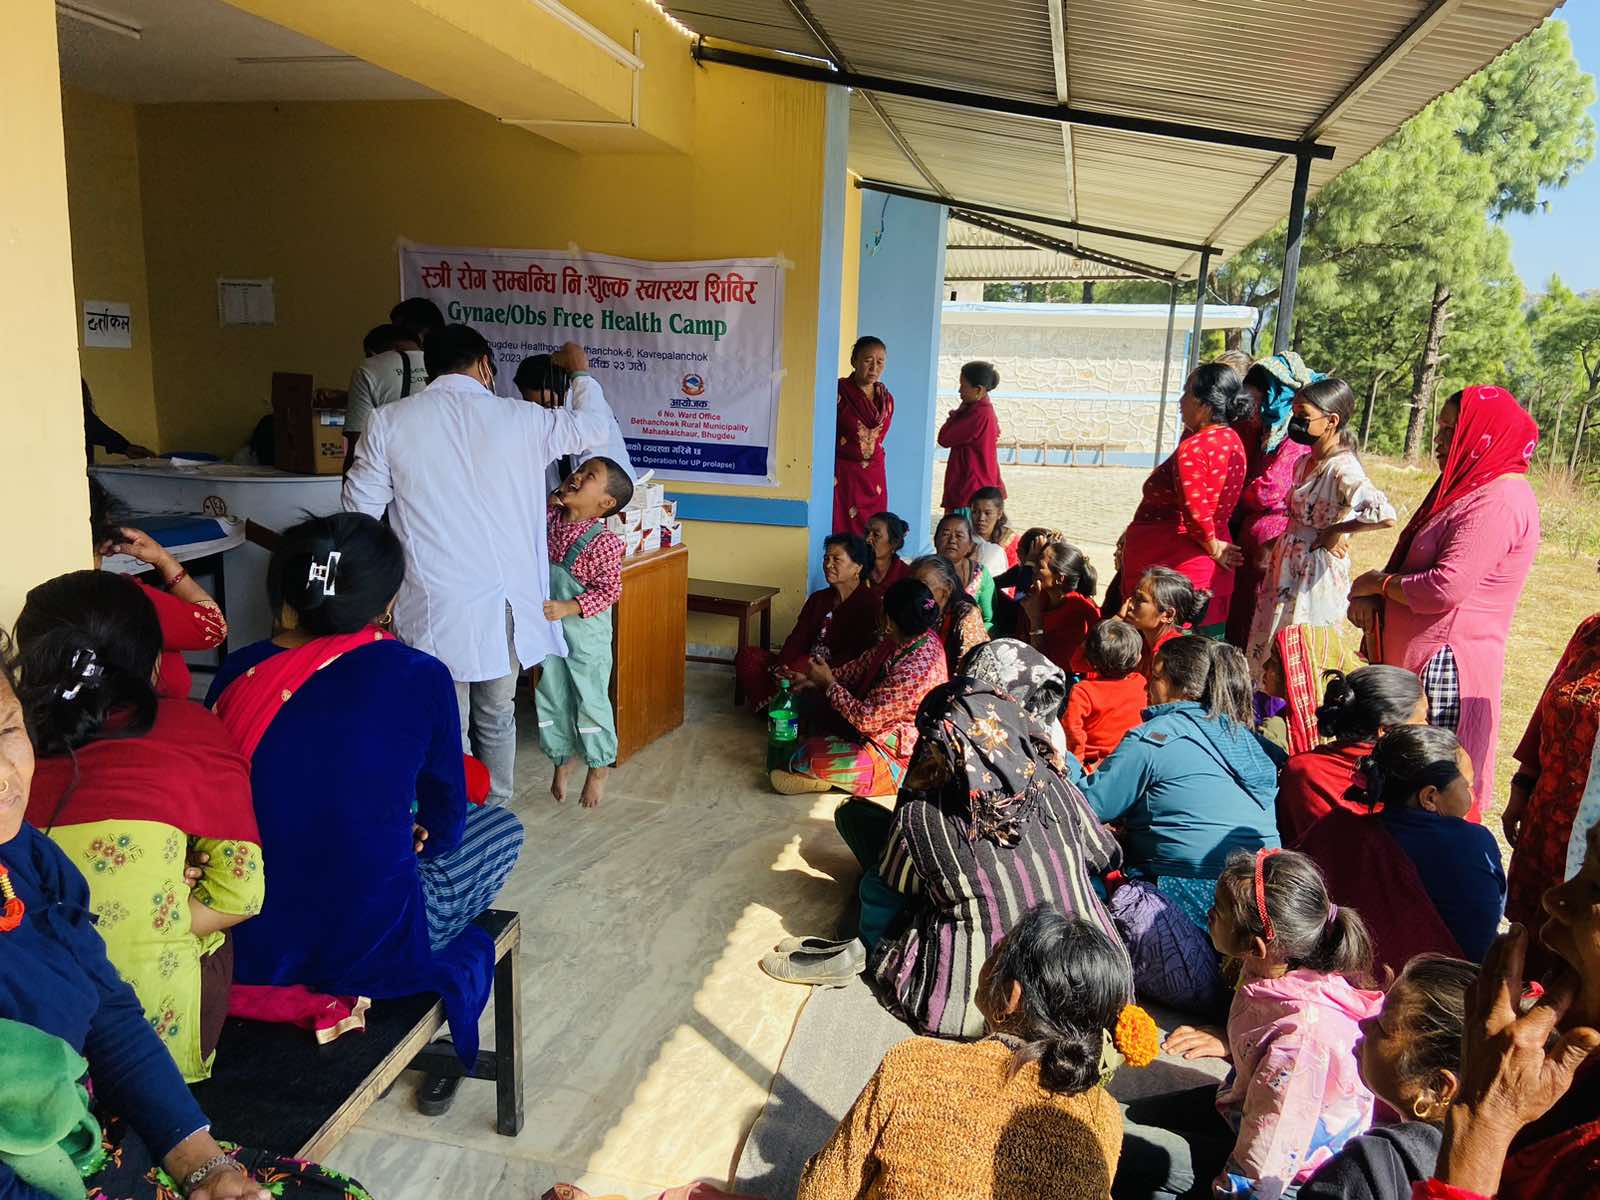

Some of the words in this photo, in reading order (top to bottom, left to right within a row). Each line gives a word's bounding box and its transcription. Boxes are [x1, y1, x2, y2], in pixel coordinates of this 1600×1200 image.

[421, 261, 452, 288] स्त्री
[457, 261, 487, 290] रोग
[492, 264, 557, 294] सम्बन्धि
[636, 279, 699, 302] स्वास्थ्य
[705, 272, 758, 304] शिविर
[447, 301, 547, 327] Gynae/Obs
[553, 306, 594, 329] Free
[600, 309, 662, 333] Health
[669, 313, 728, 342] Camp
[487, 340, 518, 351] hugdeu
[637, 348, 709, 362] Kavrepalanchok
[501, 353, 521, 363] 2023
[613, 361, 625, 370] २३
[677, 411, 697, 420] Ward
[698, 412, 721, 421] Office
[630, 417, 680, 428] Bethanchowk
[681, 421, 701, 429] Rural
[703, 422, 749, 432] Municipality
[701, 430, 736, 441] Bhugdeu
[642, 455, 678, 466] Operation
[679, 458, 689, 466] for
[690, 459, 701, 467] UP
[702, 460, 736, 470] prolapse)
